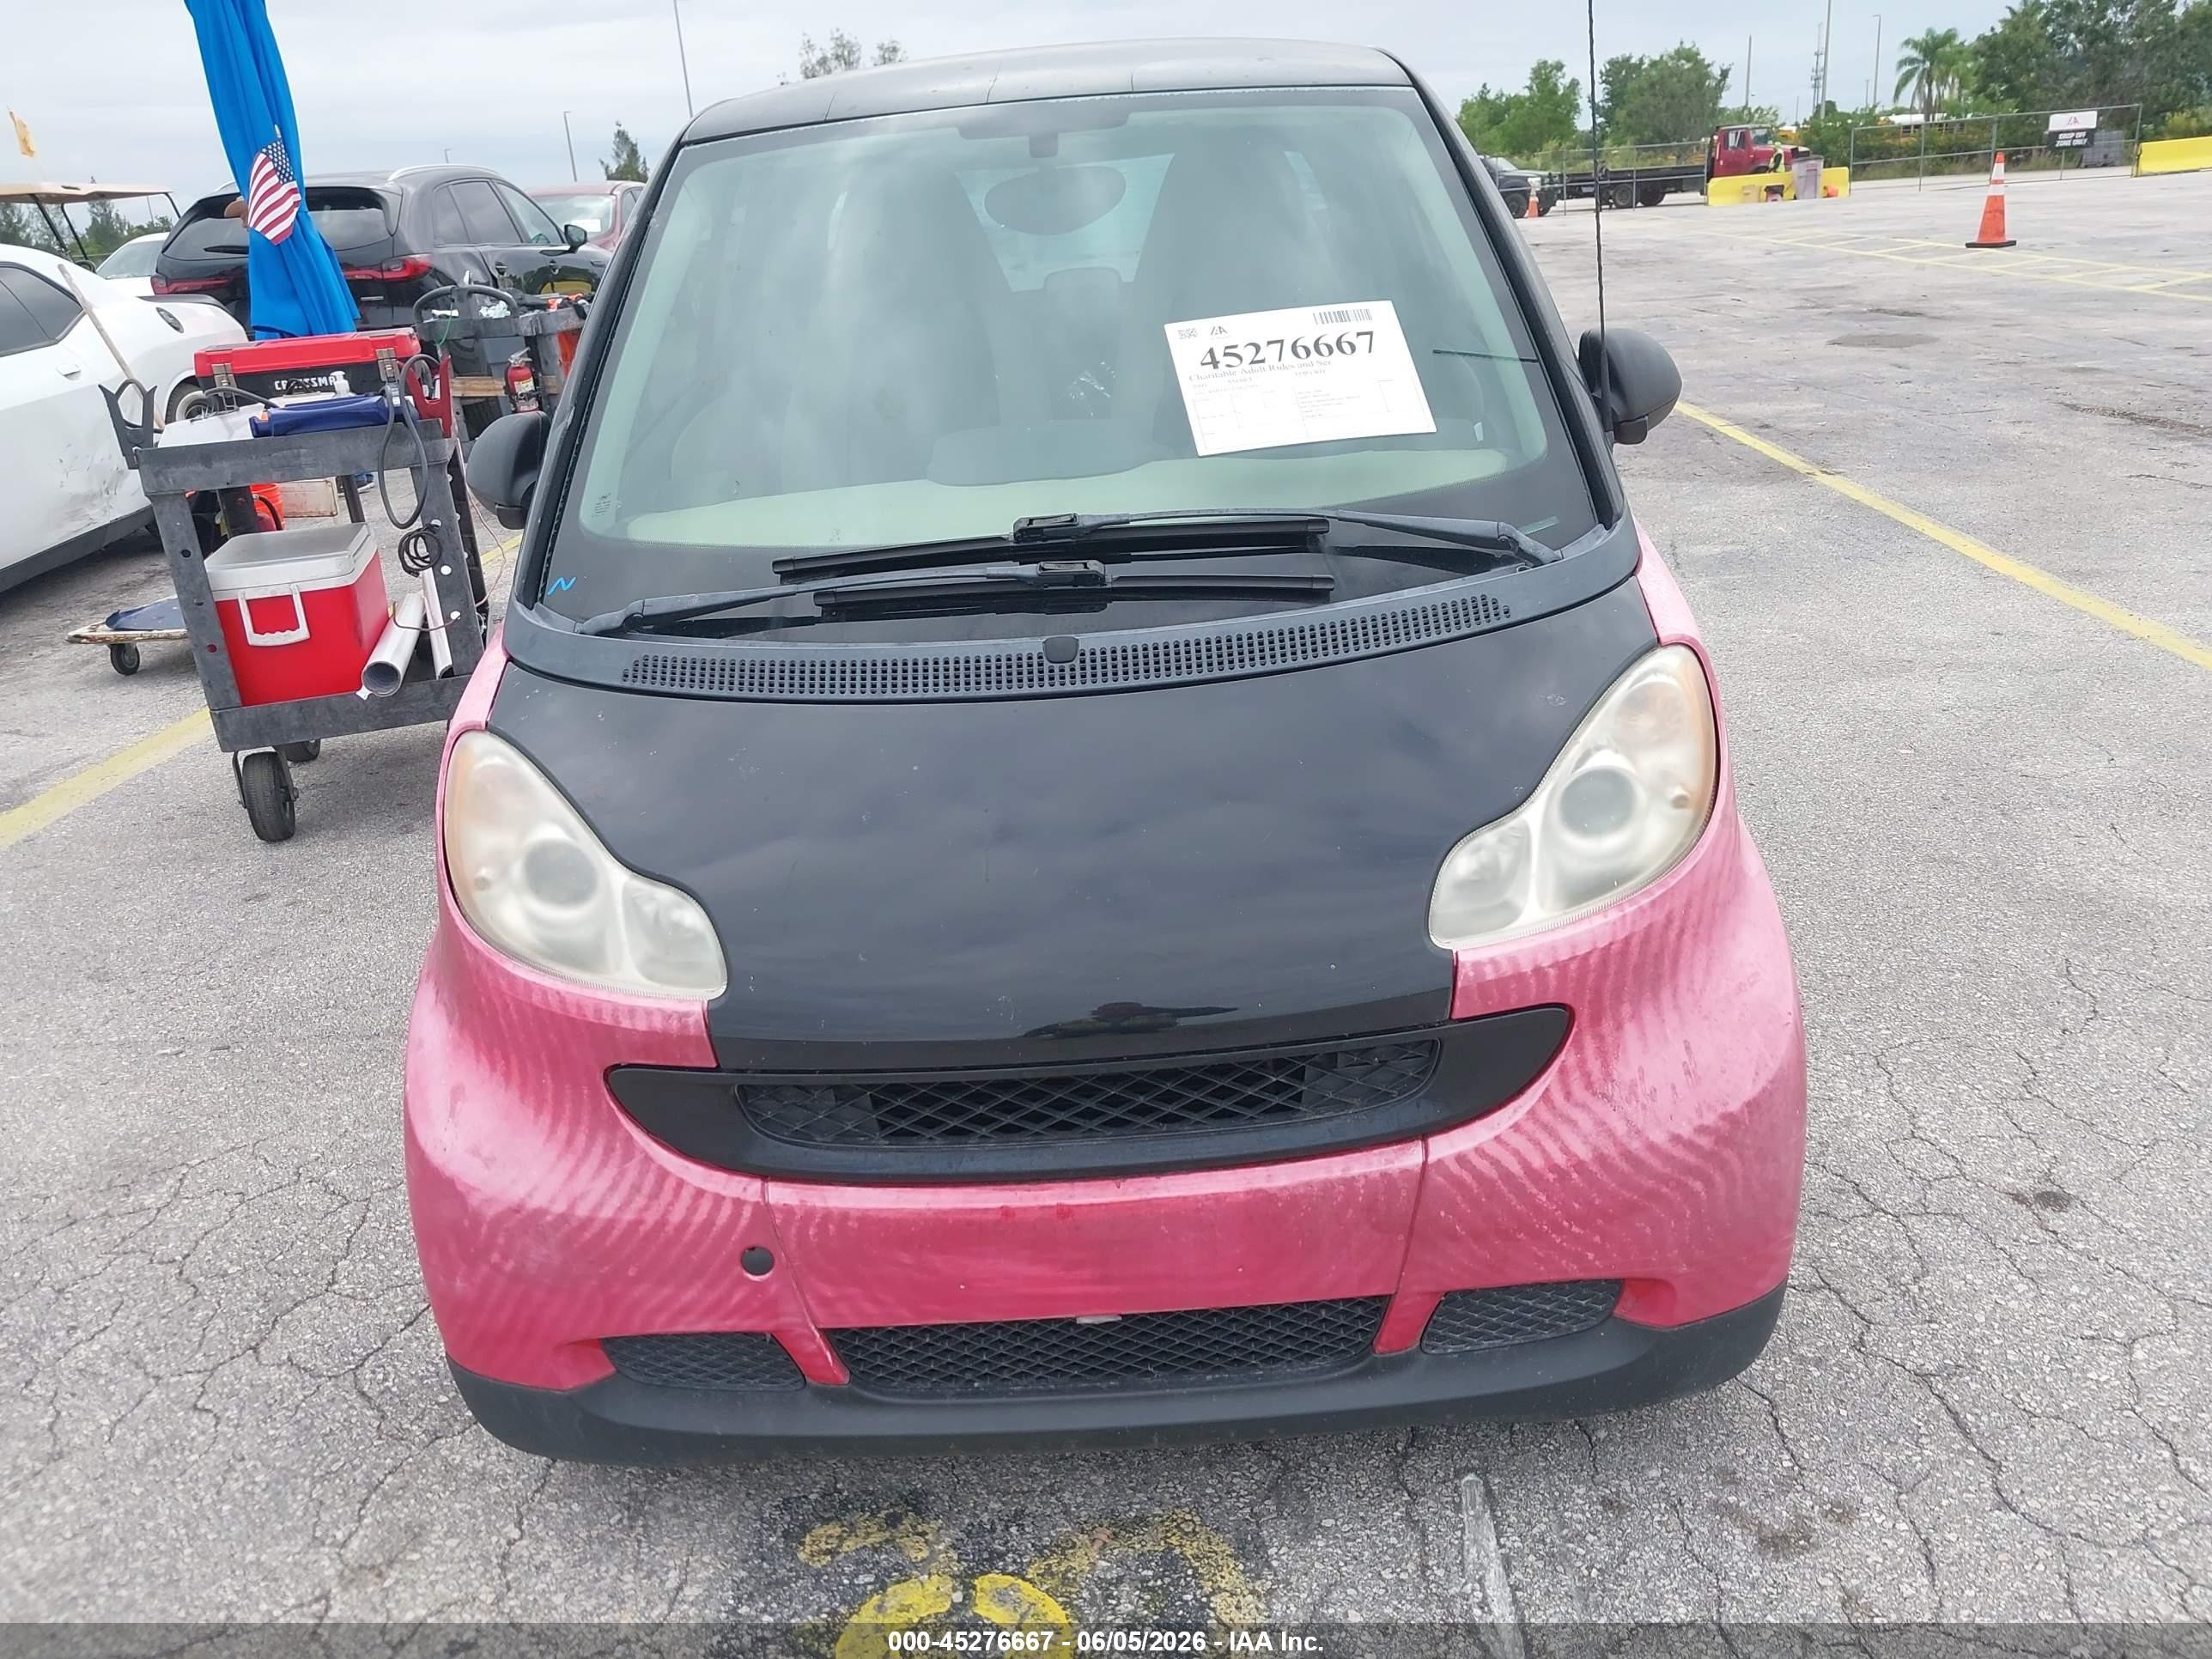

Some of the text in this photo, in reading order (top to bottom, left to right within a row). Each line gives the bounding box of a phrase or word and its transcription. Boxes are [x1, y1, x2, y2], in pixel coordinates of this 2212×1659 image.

[1200, 331, 1374, 370] 45276667
[1188, 369, 1237, 382] Charitable
[1297, 360, 1314, 369] and
